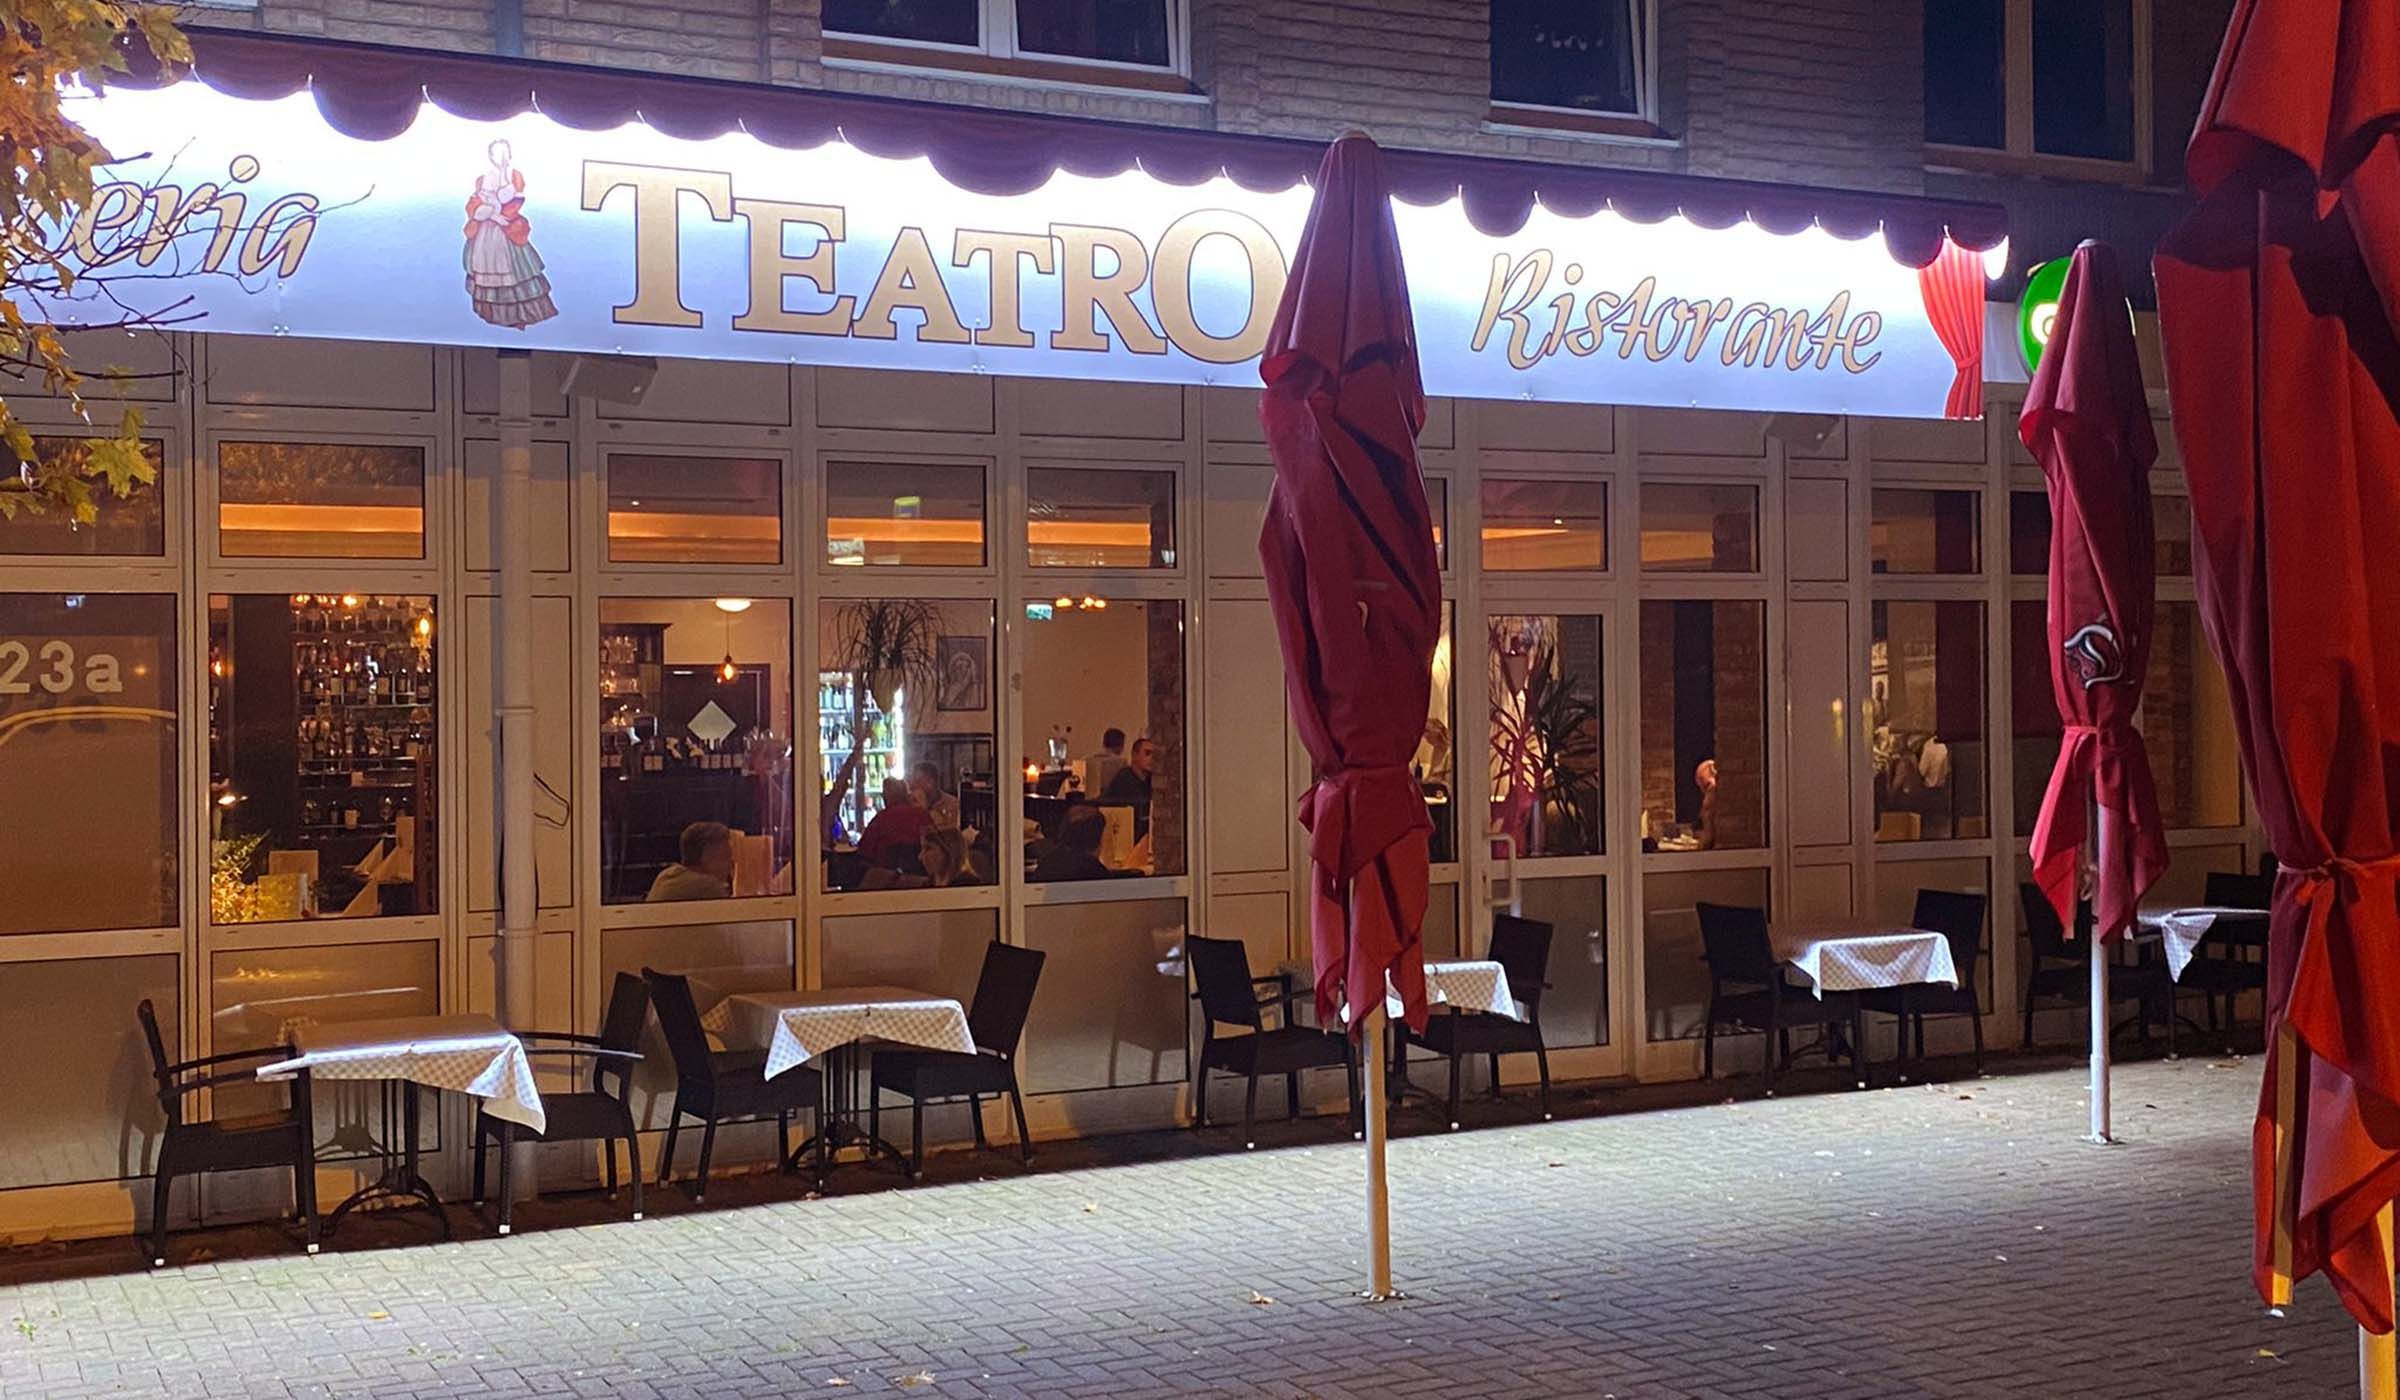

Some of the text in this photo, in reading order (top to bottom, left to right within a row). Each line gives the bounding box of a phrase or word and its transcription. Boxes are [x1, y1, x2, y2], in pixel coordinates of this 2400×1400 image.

[2, 154, 1883, 374] eria TEATRO Ristorante
[0, 640, 123, 693] 23a
